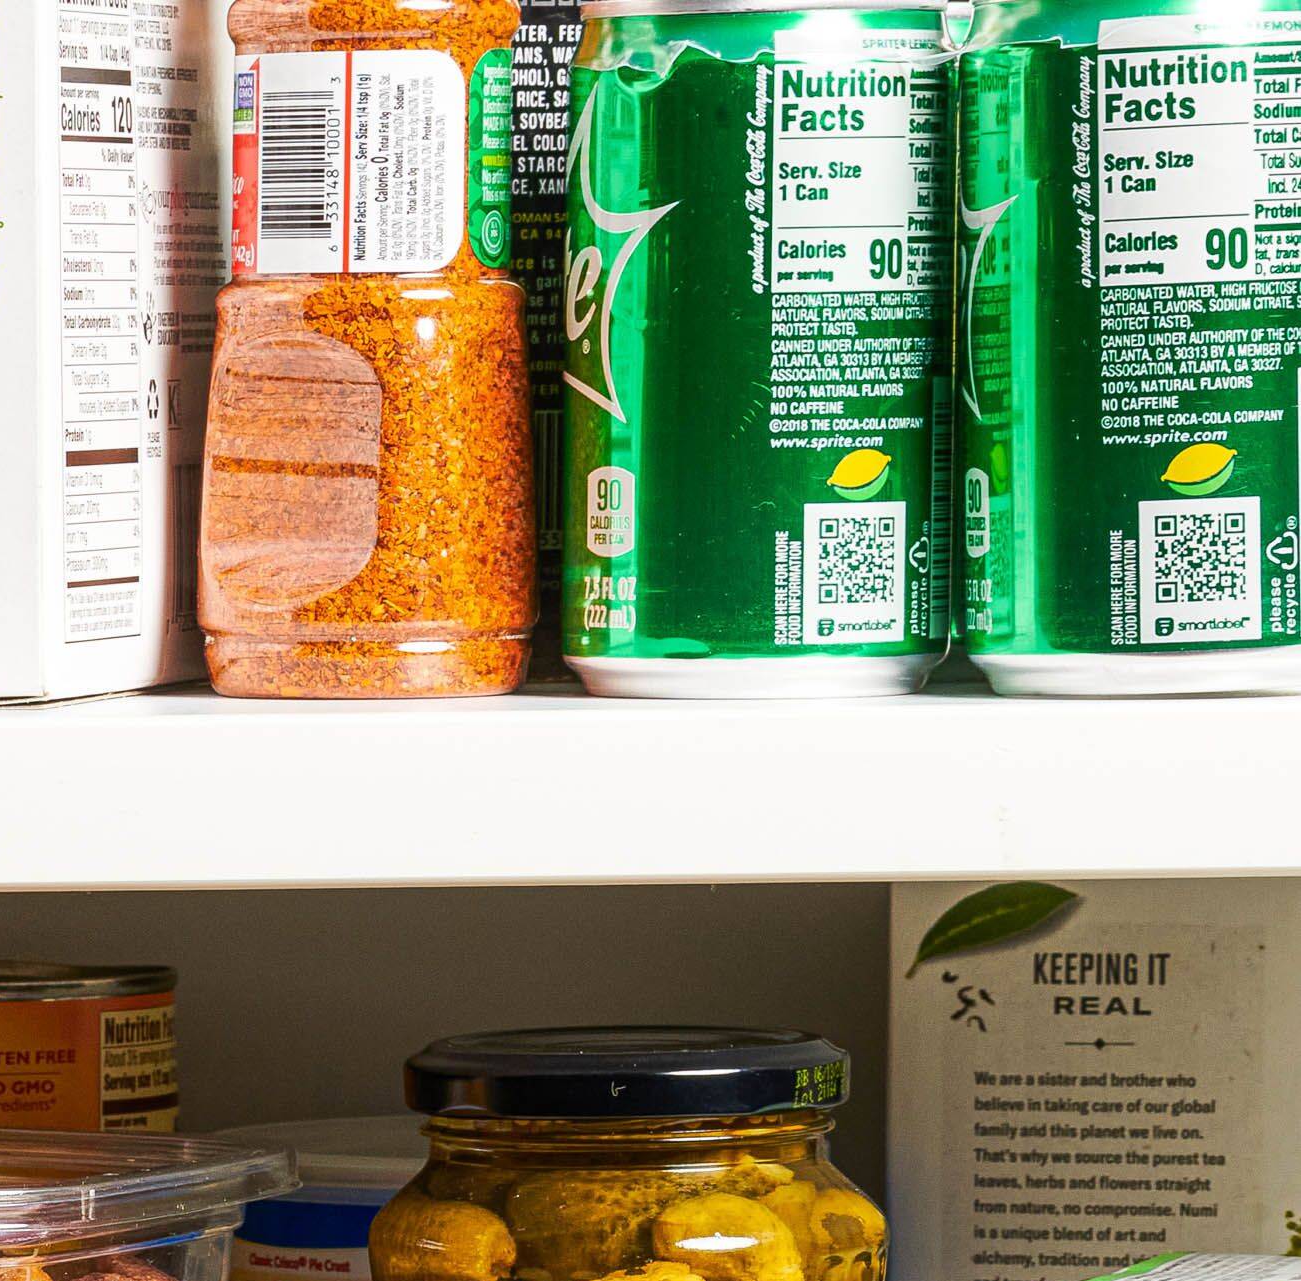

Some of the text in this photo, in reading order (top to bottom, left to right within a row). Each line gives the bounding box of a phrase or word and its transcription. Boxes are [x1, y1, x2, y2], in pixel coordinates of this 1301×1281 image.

[1105, 54, 1247, 89] Nutrition
[781, 68, 906, 98] Nutrition
[61, 102, 100, 132] Calories
[111, 97, 132, 133] 120
[1105, 91, 1196, 123] Facts
[781, 103, 864, 132] Facts
[326, 108, 341, 221] 33148 10001
[779, 161, 862, 180] Serv. Size
[1104, 151, 1194, 172] Serv. Size
[779, 184, 828, 201] 1 Can
[1105, 175, 1156, 193] 1 Can
[354, 200, 367, 261] Nutrition Facts
[1105, 227, 1247, 270] Calories 90
[778, 238, 902, 280] Calories 90
[1101, 286, 1173, 302] CARBONATED
[1102, 376, 1253, 394] 100% NATURAL FLAVORS
[1101, 396, 1179, 411] NO CAFFEINE
[1167, 410, 1284, 426] COCA-COLA COMPANY
[770, 436, 883, 451] www.sprite.com
[1102, 429, 1227, 447] www.sprite.com
[1270, 577, 1284, 632] please
[1284, 573, 1298, 634] recycle
[1033, 952, 1171, 986] KEEPING IT
[1053, 997, 1152, 1016] REAL
[36, 1049, 77, 1064] FREE
[9, 1080, 55, 1095] GMO
[1038, 1073, 1163, 1088] sister brother
[1099, 1175, 1211, 1195] flowers straight
[1179, 1204, 1218, 1217] Numi
